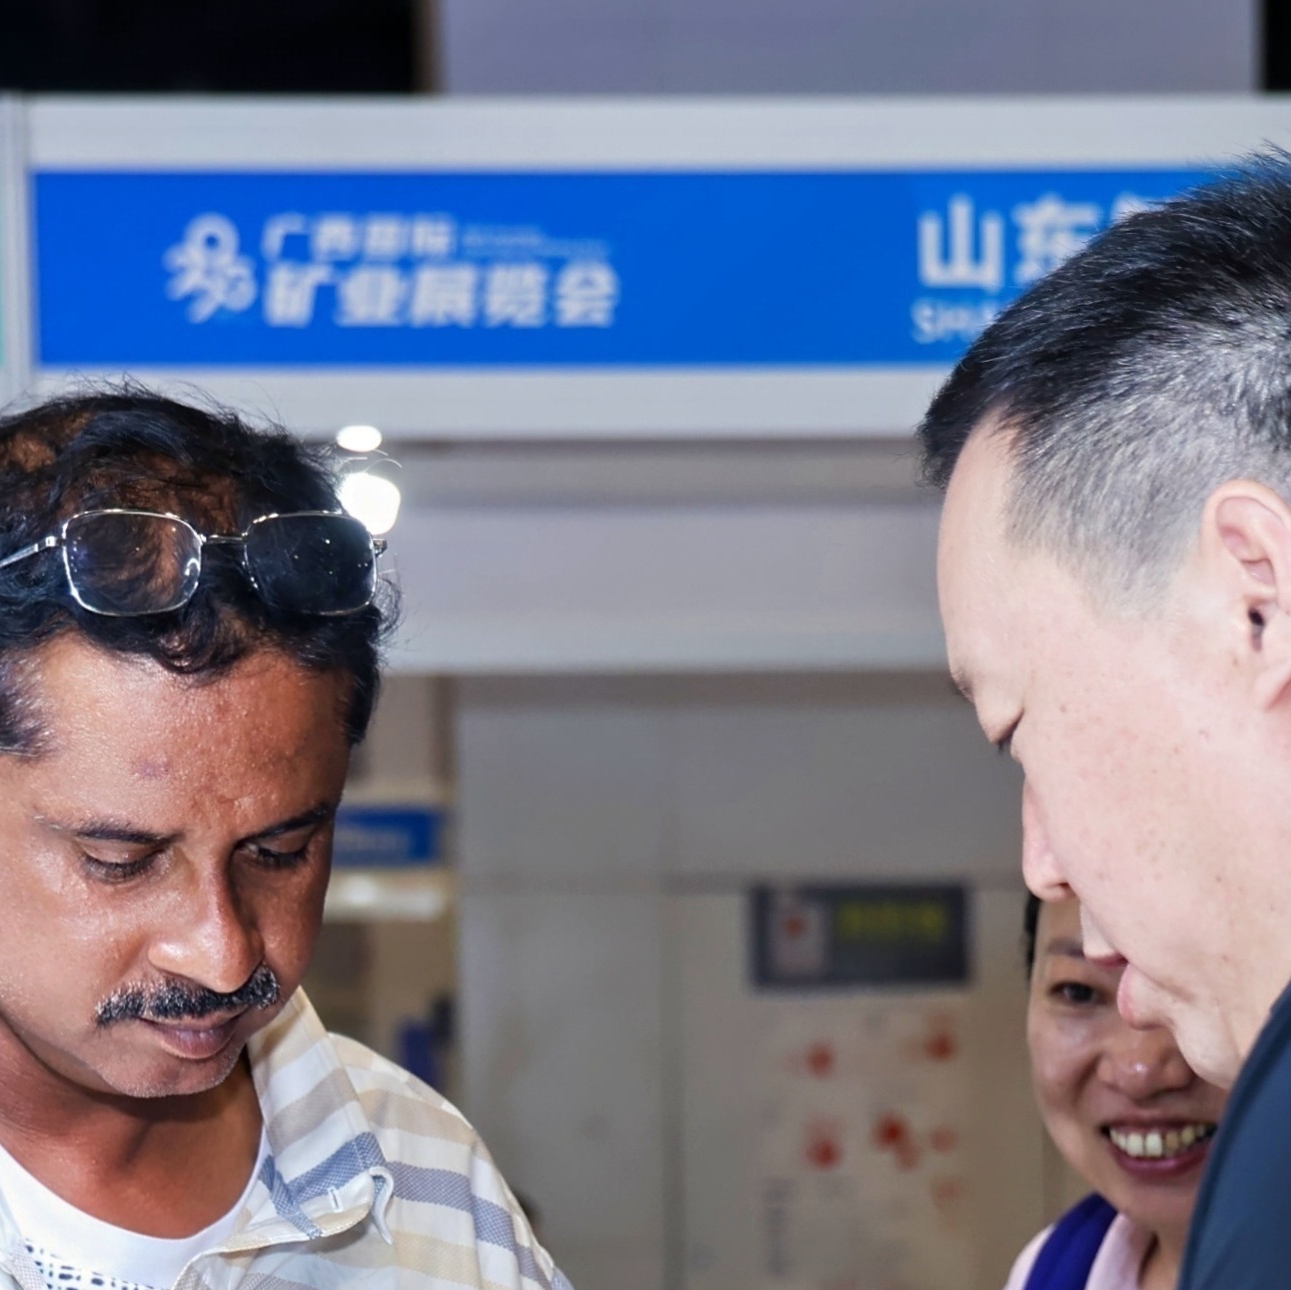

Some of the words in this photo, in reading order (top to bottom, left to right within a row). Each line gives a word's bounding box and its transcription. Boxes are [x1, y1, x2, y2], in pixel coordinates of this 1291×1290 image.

[264, 260, 618, 328] 矿业展览会
